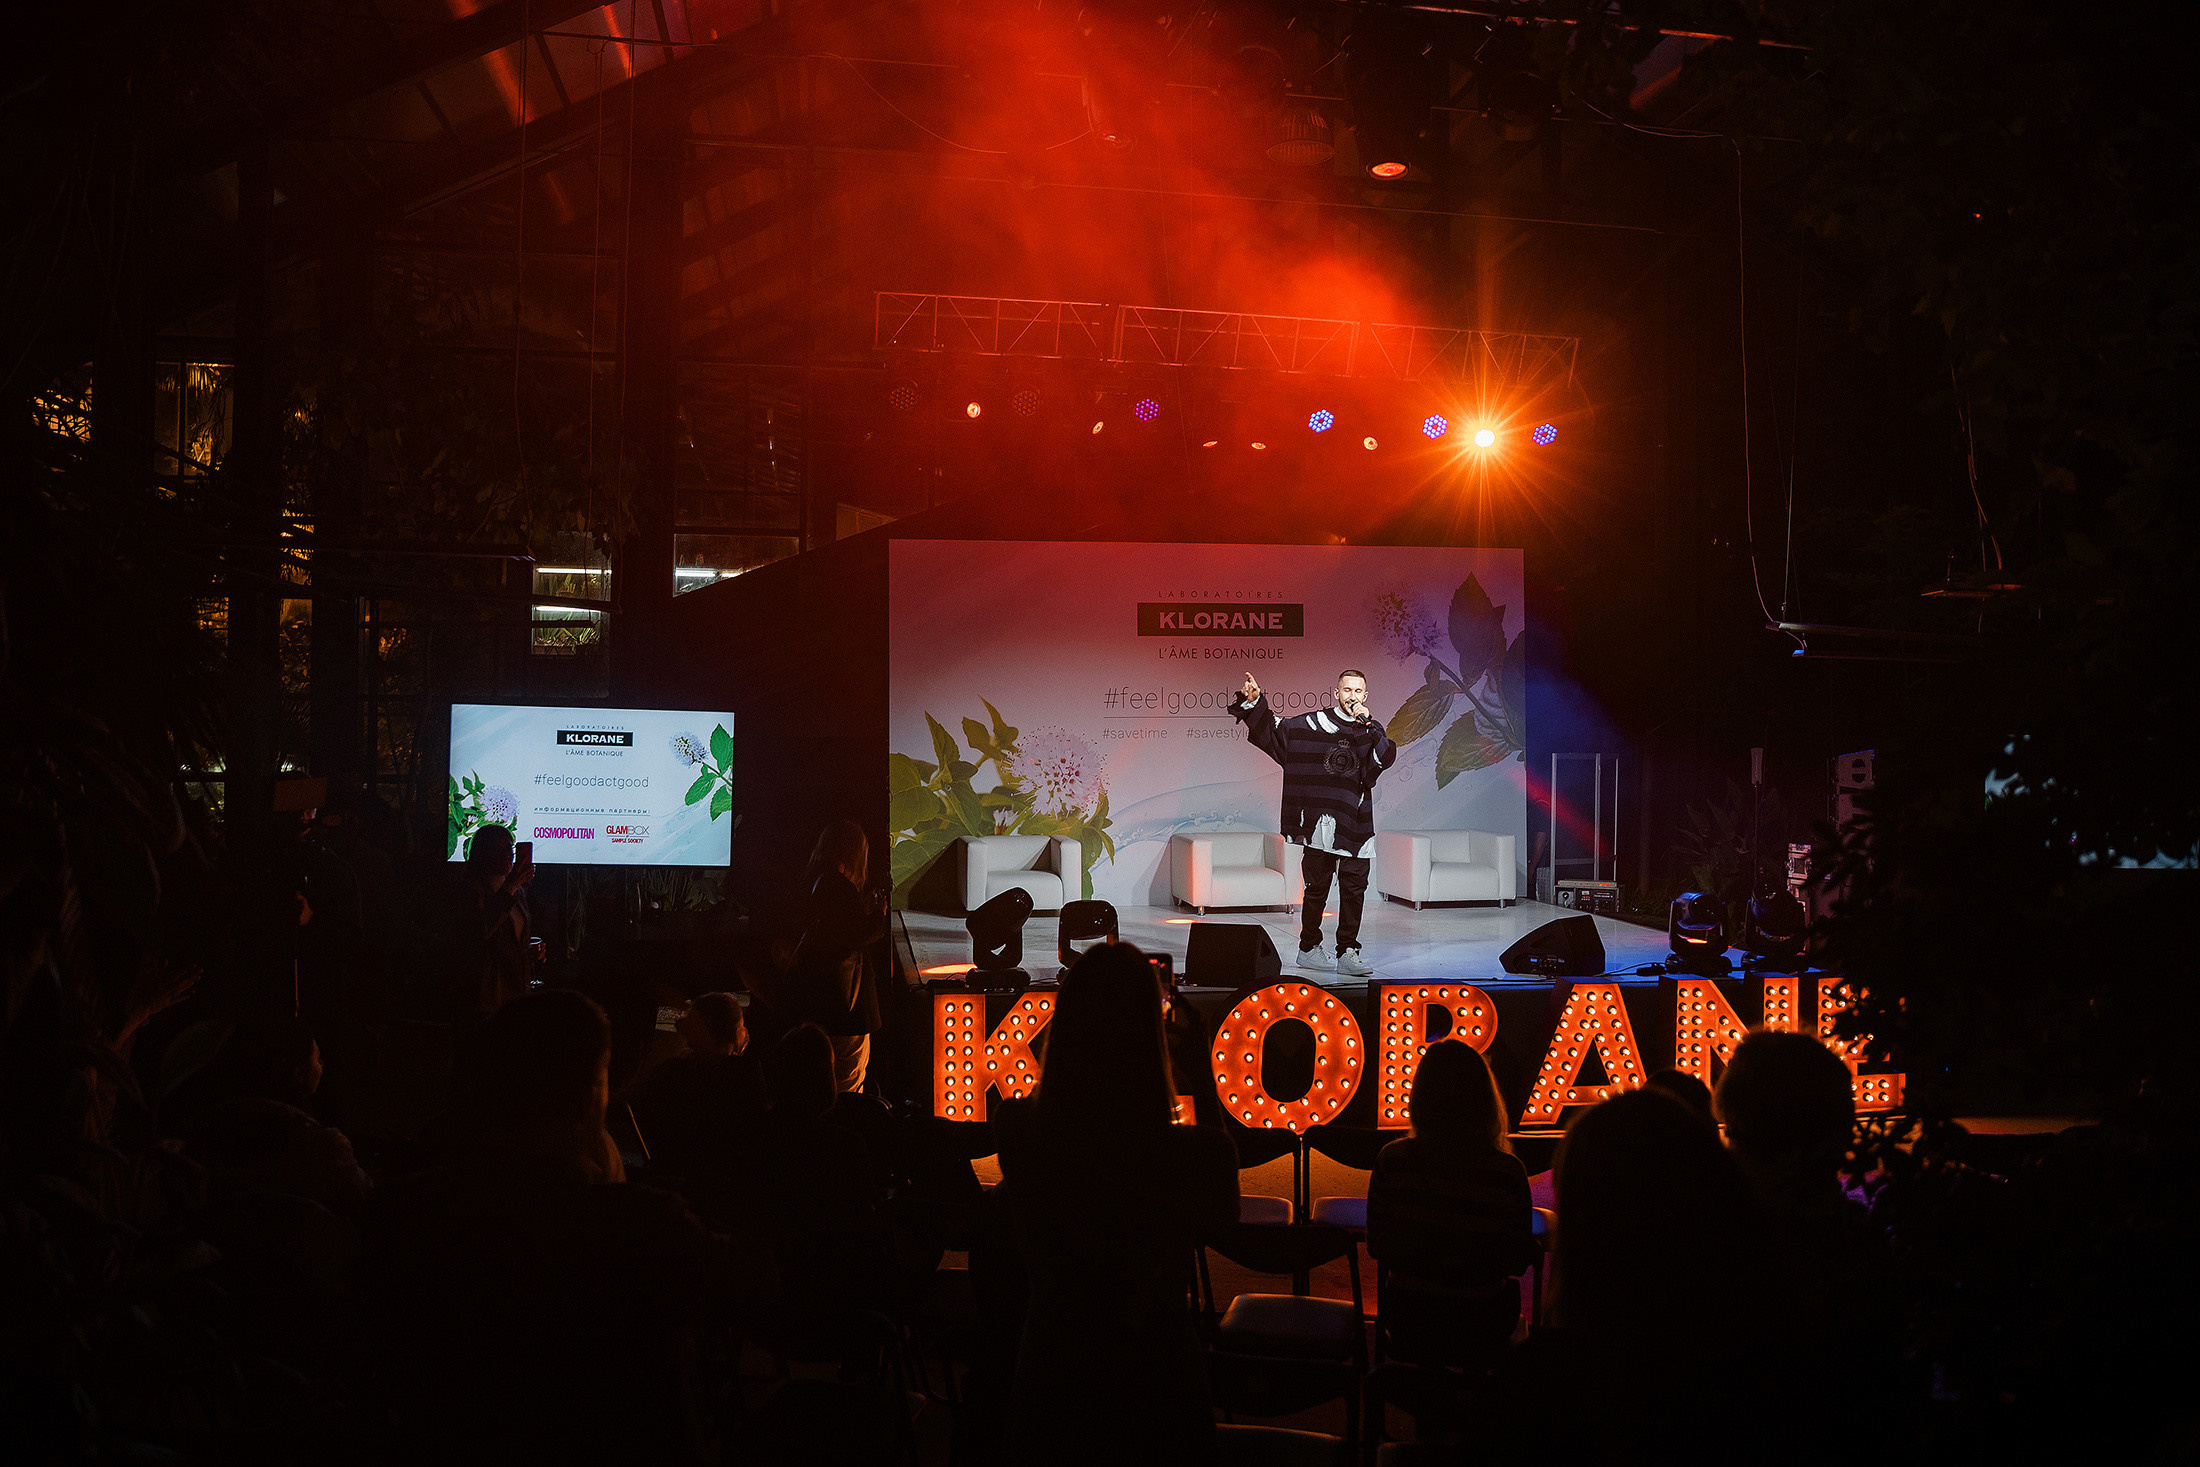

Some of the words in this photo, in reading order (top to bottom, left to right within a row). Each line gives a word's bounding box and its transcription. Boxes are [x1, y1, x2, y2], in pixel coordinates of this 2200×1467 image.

[1158, 590, 1283, 599] LABORATOIRES
[1160, 611, 1283, 630] KLORANE
[1204, 647, 1284, 659] BOTANIQUE
[565, 733, 625, 744] KLORANE
[1102, 727, 1168, 739] #savetime
[534, 773, 649, 789] #feelgoodactgood
[534, 806, 605, 814] информационные
[533, 826, 595, 840] COSMOPOLITAN
[606, 825, 650, 836] GLAMBOX
